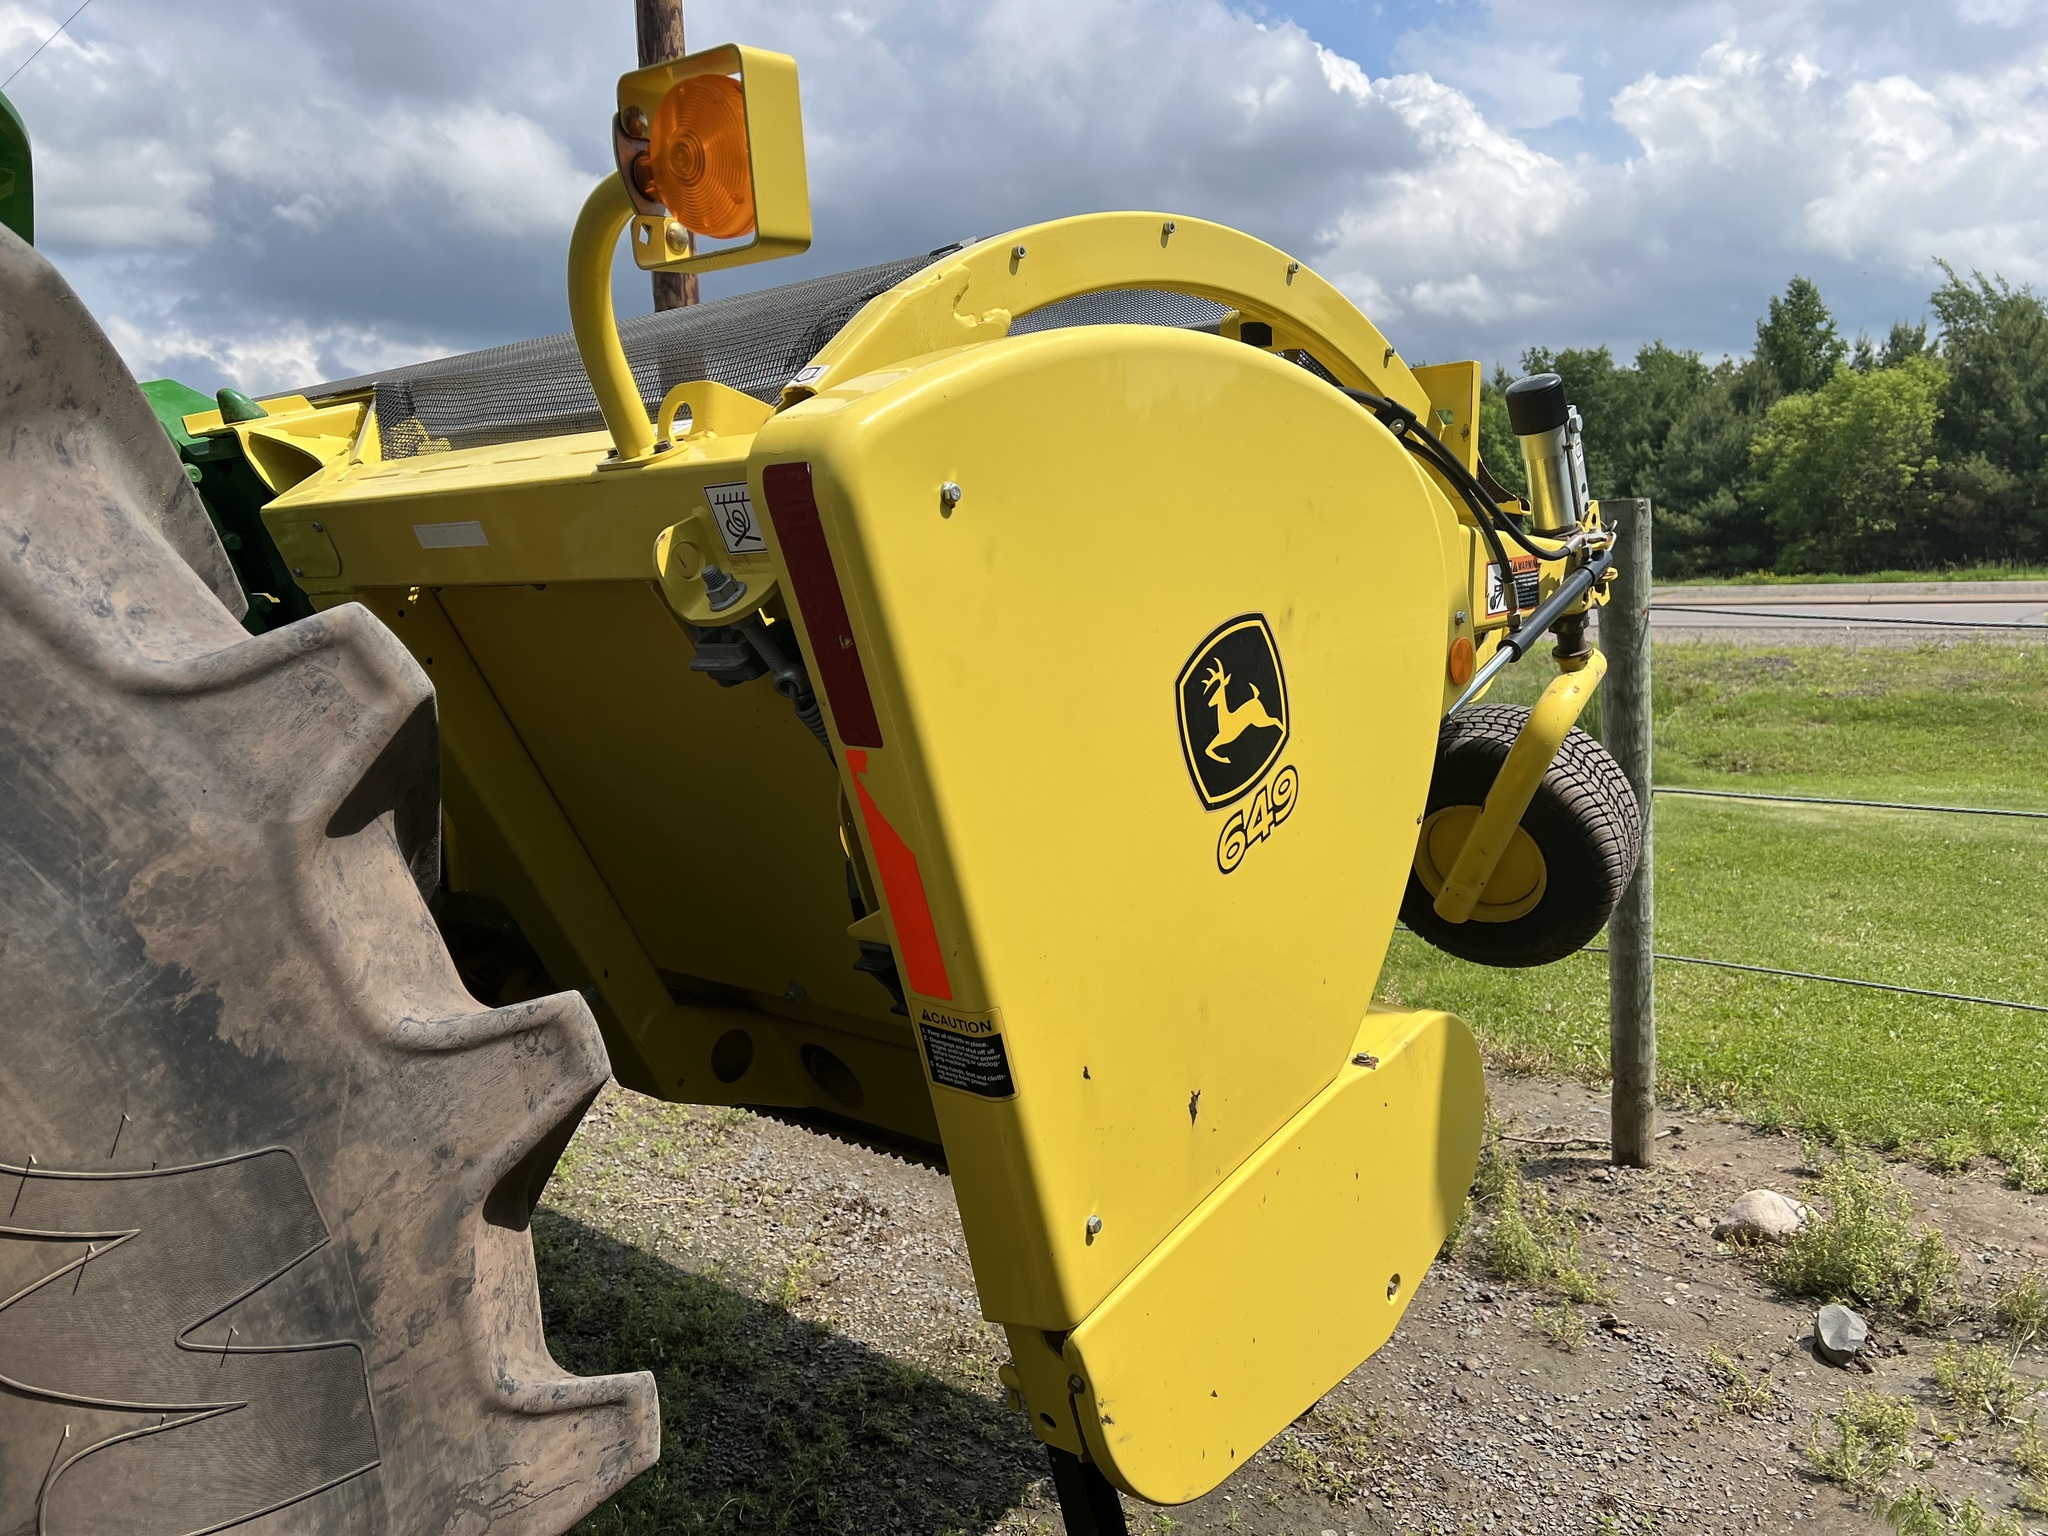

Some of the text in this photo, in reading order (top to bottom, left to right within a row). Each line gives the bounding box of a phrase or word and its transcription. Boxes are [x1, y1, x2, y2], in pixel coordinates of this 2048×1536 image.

[1217, 765, 1298, 874] 649
[931, 1012, 992, 1033] CAUTION
[928, 1029, 940, 1037] Keep
[947, 1035, 964, 1044] shields
[929, 1038, 954, 1048] Disengage
[931, 1044, 1000, 1062] engine and/or motor power
[932, 1048, 947, 1057] before
[948, 1053, 970, 1063] servicing
[936, 1062, 948, 1071] Keep
[949, 1066, 965, 1076] hands,
[945, 1058, 967, 1067] machine.
[946, 1071, 958, 1079] away
[959, 1074, 970, 1082] from
[954, 1079, 968, 1087] parts.
